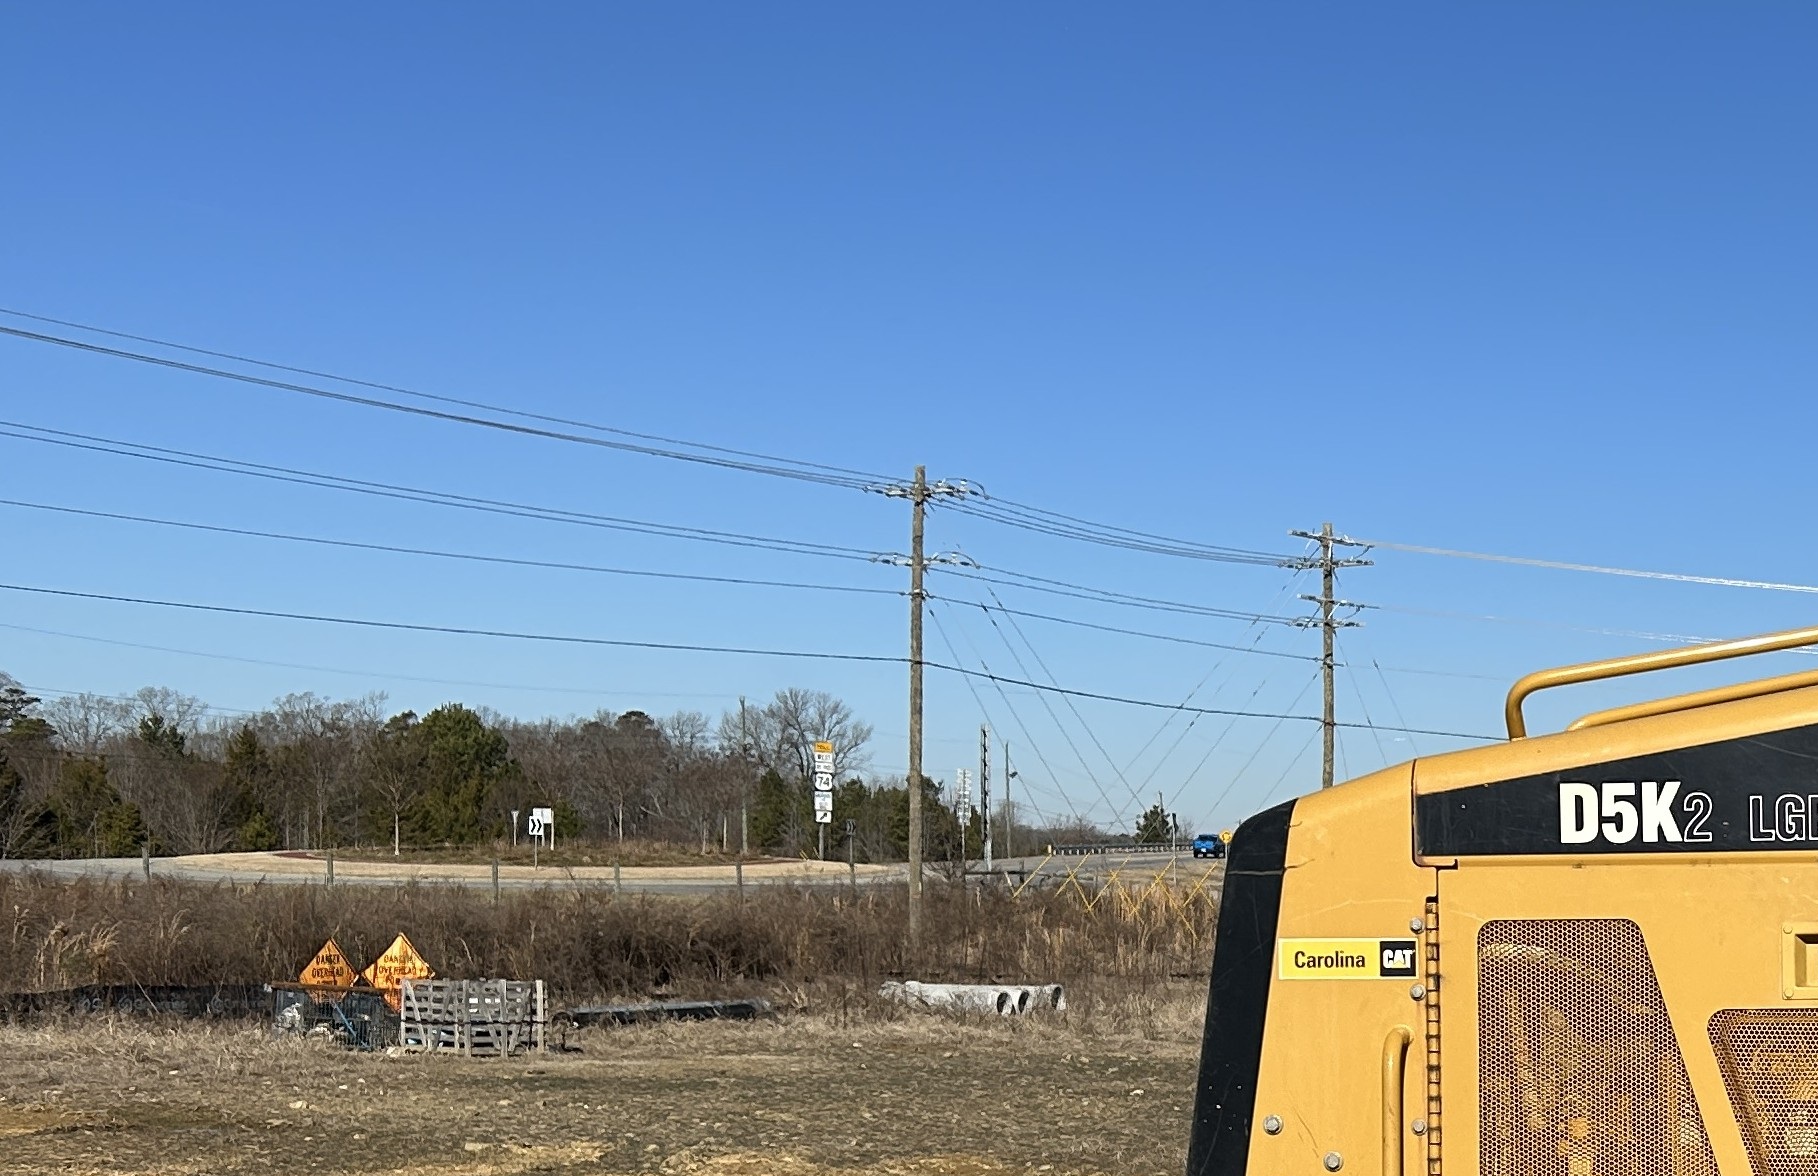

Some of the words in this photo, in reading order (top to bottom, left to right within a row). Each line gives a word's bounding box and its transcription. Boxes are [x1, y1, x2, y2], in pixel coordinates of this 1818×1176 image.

[818, 775, 830, 787] 74
[1294, 950, 1366, 968] Carolina
[1382, 949, 1414, 969] CAT
